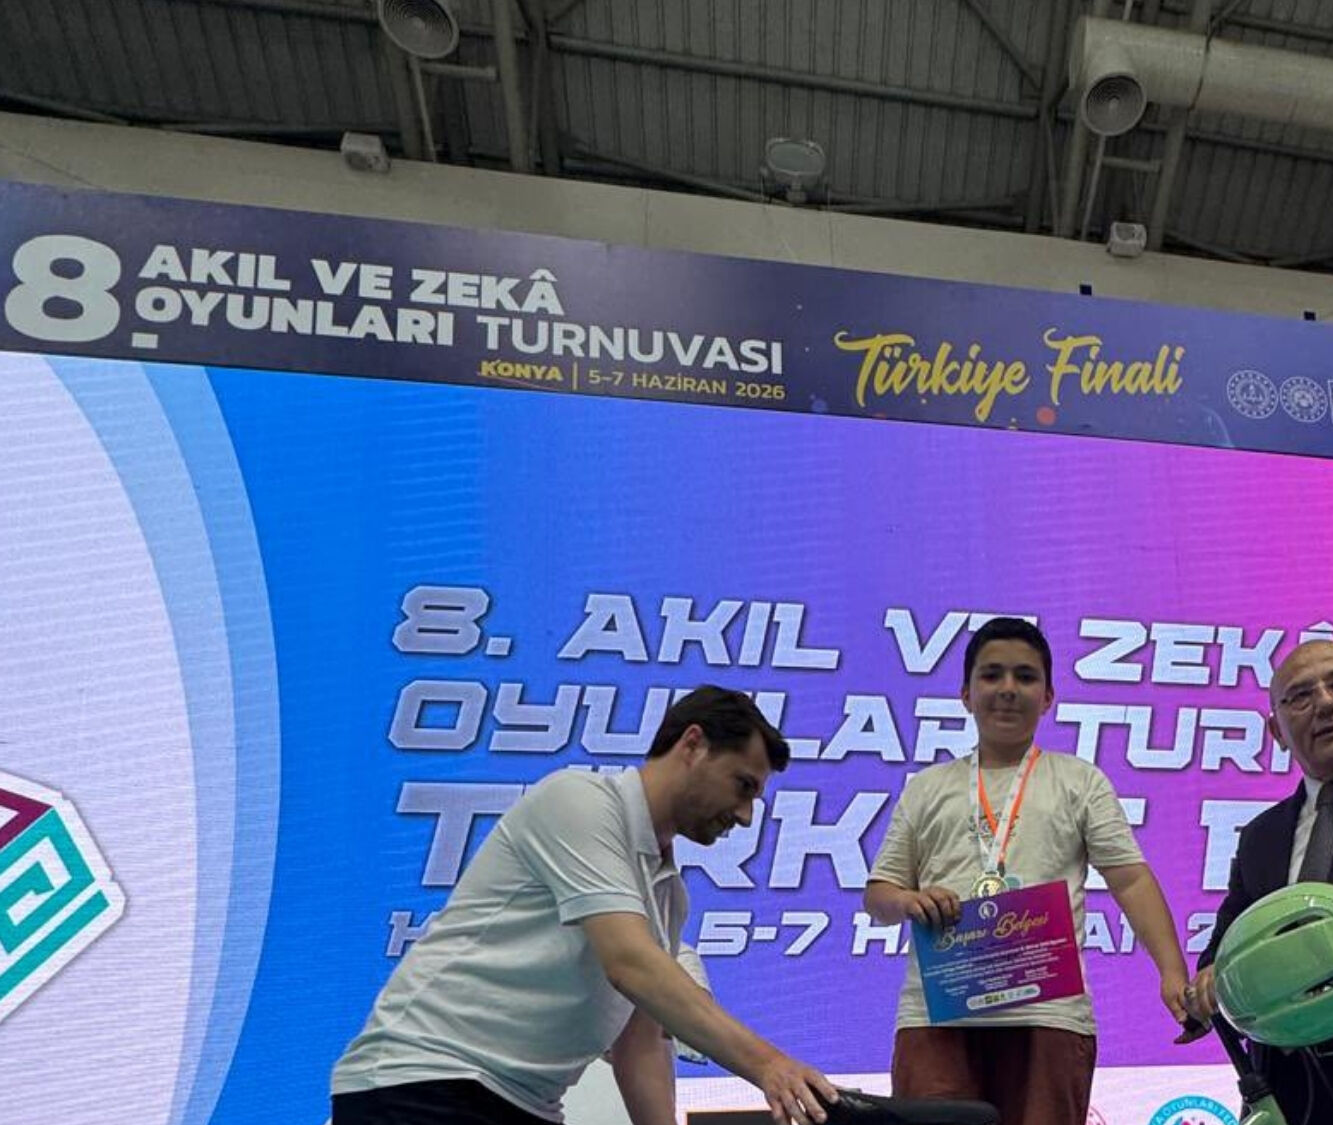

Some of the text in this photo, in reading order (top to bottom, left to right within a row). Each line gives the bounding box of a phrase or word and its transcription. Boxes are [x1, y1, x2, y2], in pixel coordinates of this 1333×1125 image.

[4, 234, 158, 349] 8.
[138, 245, 566, 318] AKIL VE ZEKÂ
[135, 286, 784, 376] OYUNLARI TURNUVASI
[481, 360, 787, 401] KONYA 5-7 HAZİRAN 2026
[835, 327, 1187, 422] Türkiye Finali
[392, 585, 513, 656] 8.
[557, 593, 839, 670] AKIL
[696, 911, 830, 957] 5-7
